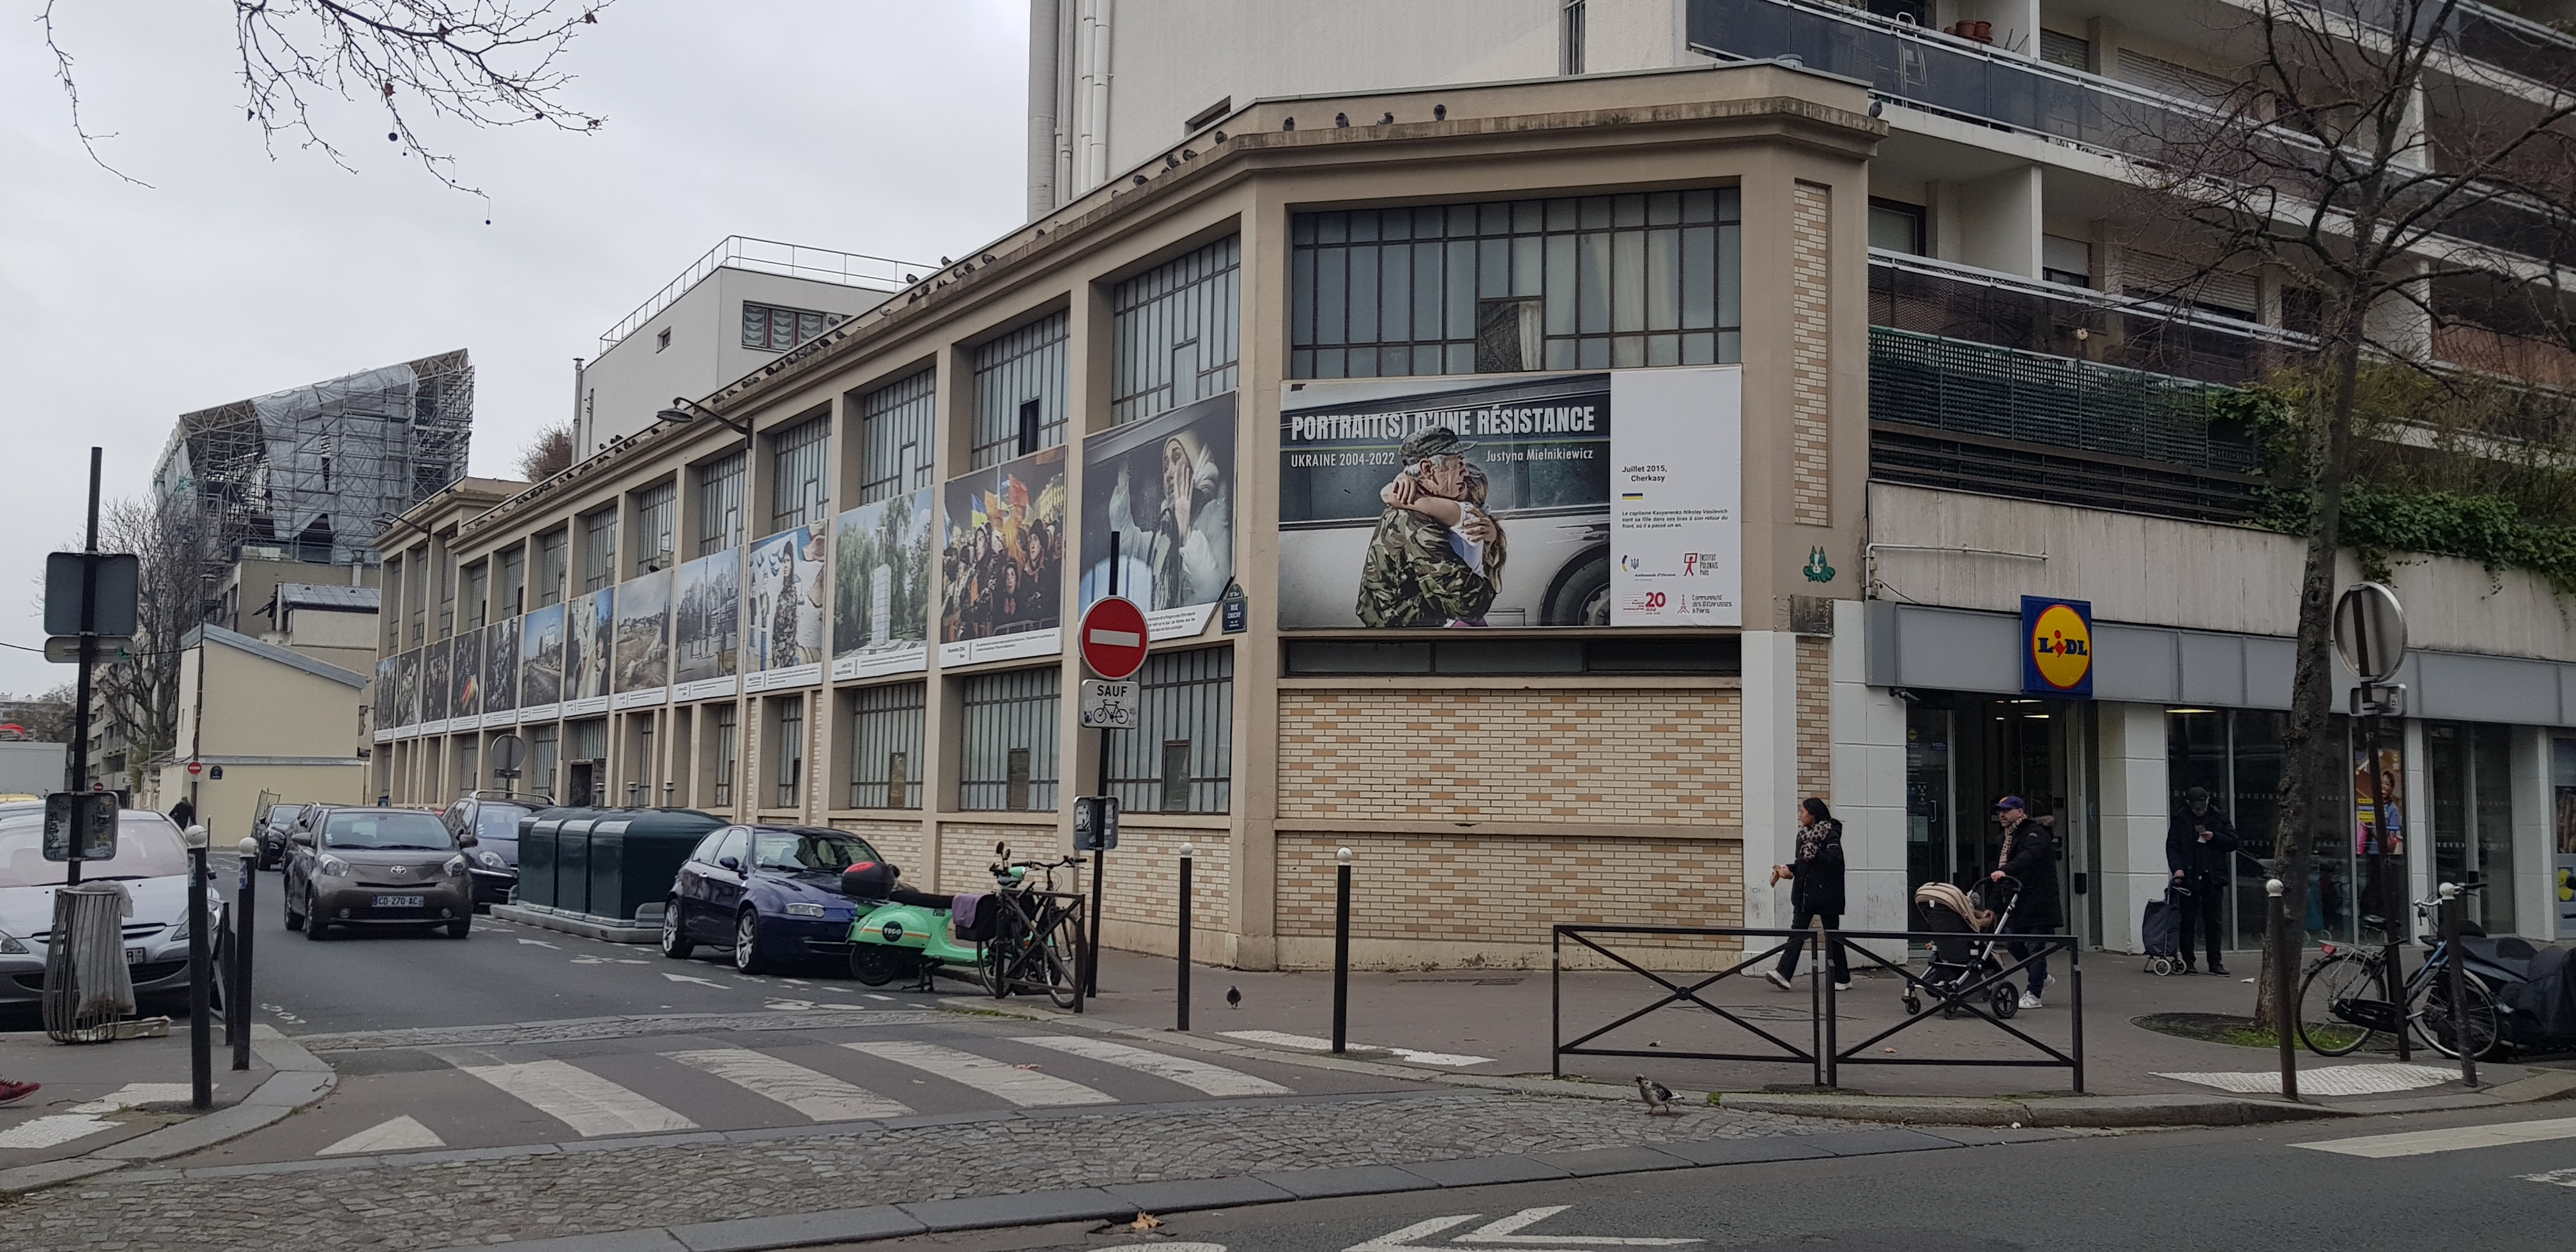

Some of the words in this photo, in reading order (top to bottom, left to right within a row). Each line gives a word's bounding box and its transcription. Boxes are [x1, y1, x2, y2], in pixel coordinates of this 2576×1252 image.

[1291, 413, 1408, 441] PORTRAIT(S)
[1414, 411, 1471, 436] D'UNE
[1477, 405, 1595, 435] RÉSISTANCE
[1291, 454, 1337, 467] UKRAINE
[1339, 452, 1395, 466] 2004-2022
[1485, 450, 1524, 464] Justyna
[1526, 448, 1593, 461] Mielnikiewicz
[1630, 475, 1666, 483] Cherkasy
[1645, 592, 1666, 607] 20
[1097, 685, 1128, 698] SAUF
